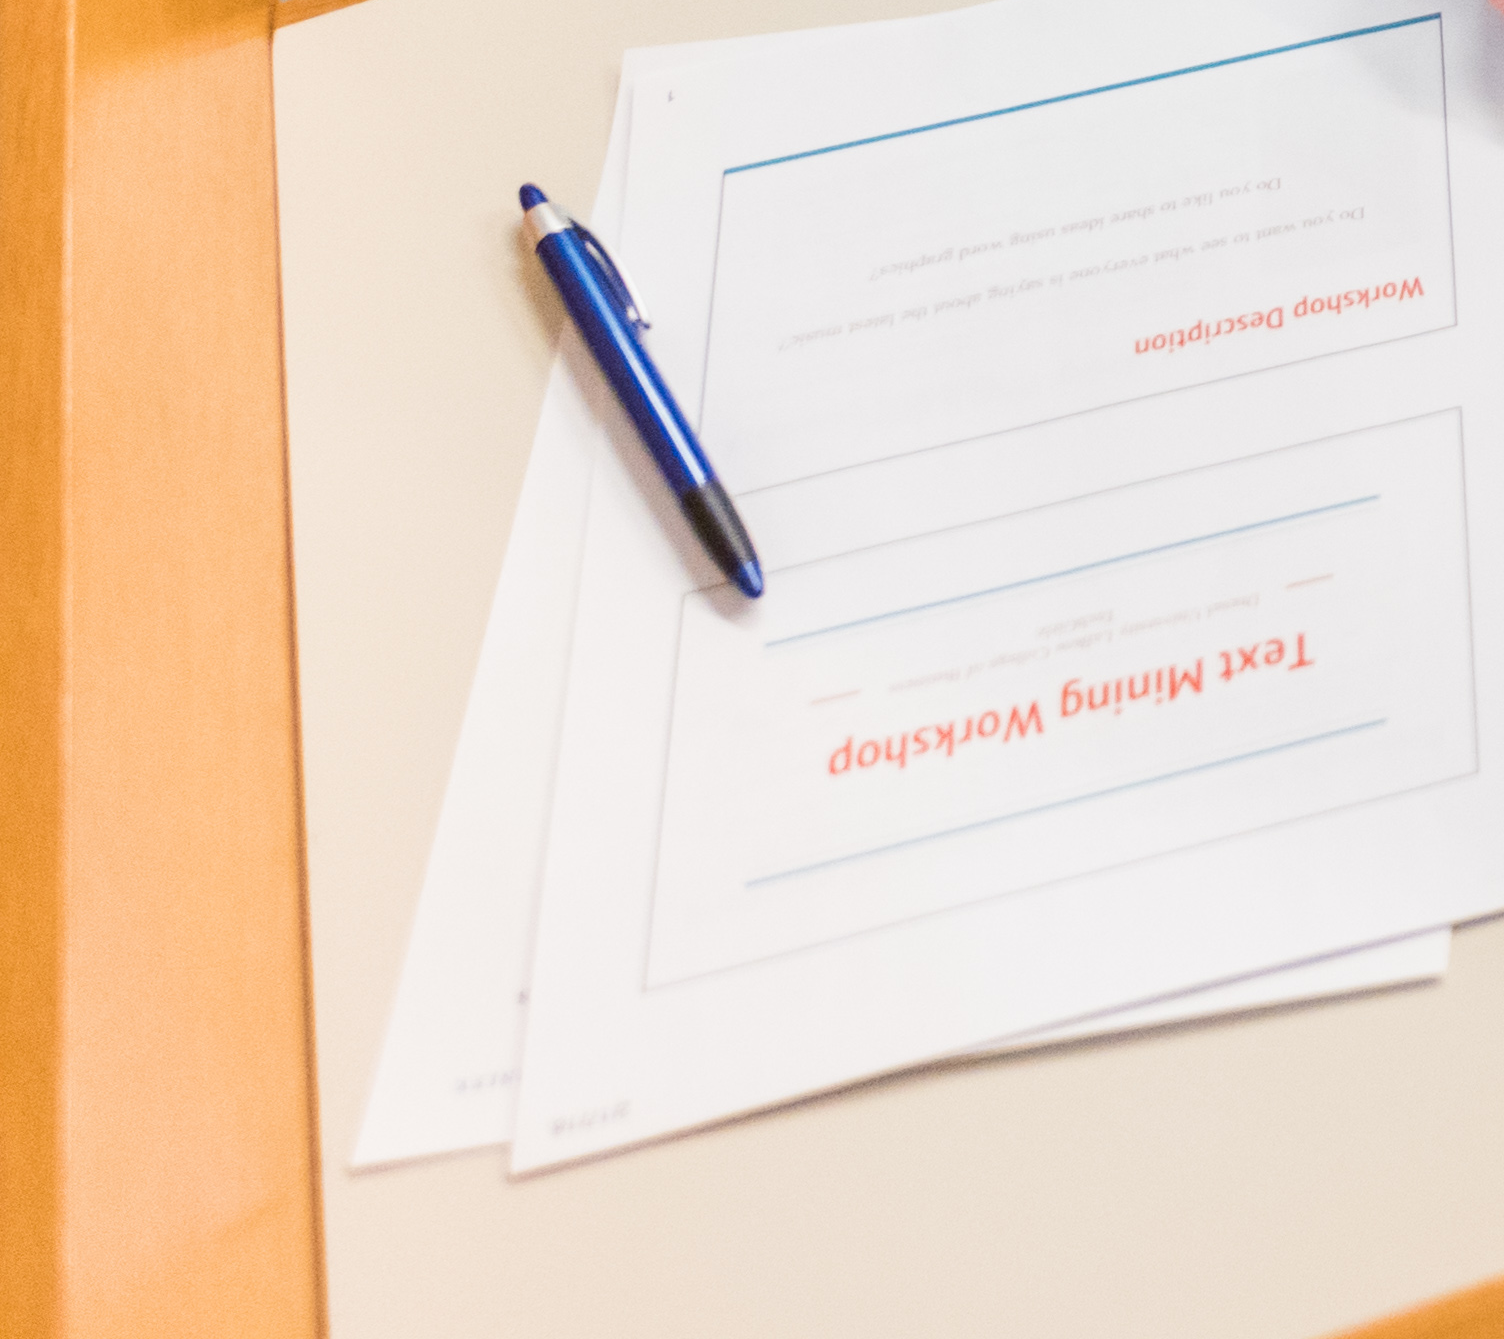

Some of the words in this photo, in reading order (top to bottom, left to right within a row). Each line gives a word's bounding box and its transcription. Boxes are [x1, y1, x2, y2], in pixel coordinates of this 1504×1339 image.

[1292, 276, 1424, 318] Workshop
[1134, 306, 1284, 354] Description
[1219, 633, 1313, 681] Text
[1060, 658, 1203, 718] Mining
[827, 700, 1044, 775] Workshop
